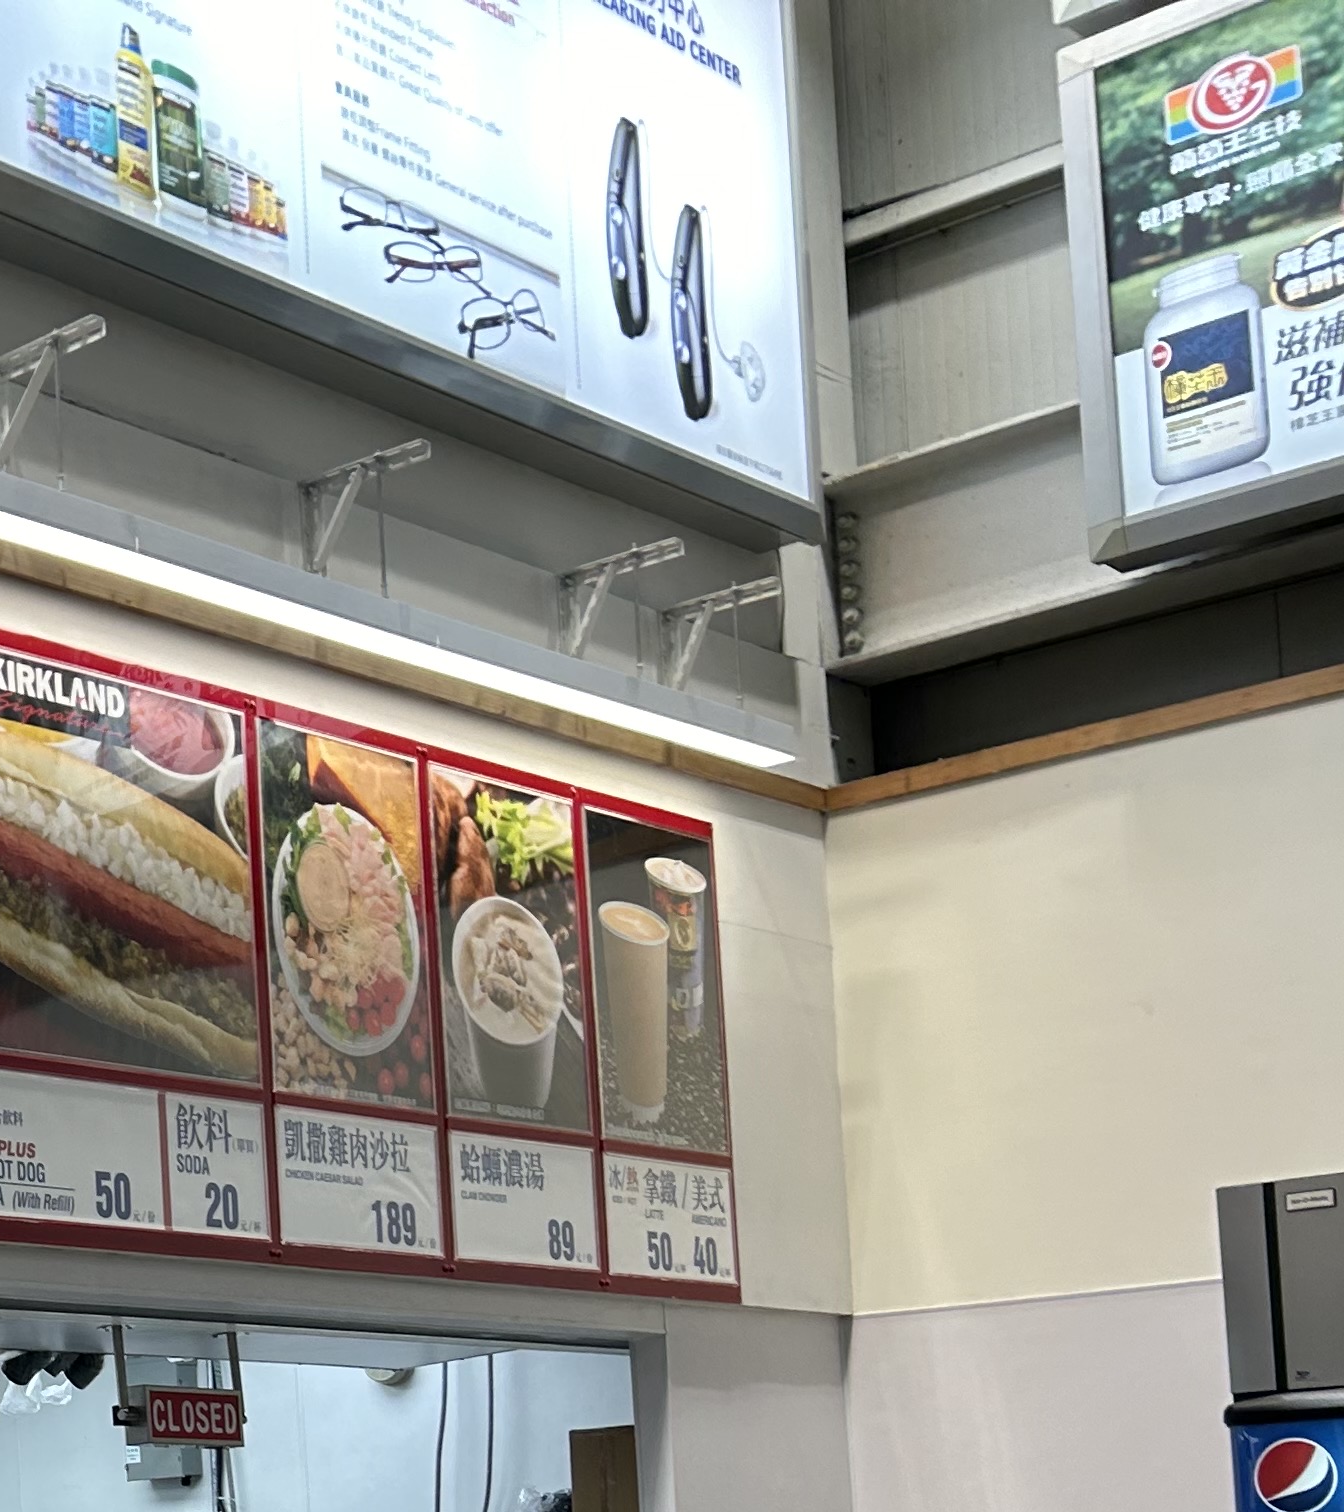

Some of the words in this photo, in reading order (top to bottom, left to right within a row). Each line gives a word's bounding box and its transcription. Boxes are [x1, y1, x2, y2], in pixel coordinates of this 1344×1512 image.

[661, 22, 686, 51] AID
[690, 39, 742, 86] CENTER
[1288, 359, 1344, 411] 強
[175, 1102, 233, 1154] 飲料
[284, 1119, 411, 1173] 凱撒雞肉沙拉
[17, 1162, 46, 1183] DOG
[176, 1153, 210, 1176] SODA
[12, 1189, 41, 1211] (With
[94, 1171, 131, 1220] 50
[205, 1182, 239, 1230] 20
[371, 1200, 416, 1247] 189
[548, 1218, 575, 1261] 89
[647, 1231, 673, 1272] 50
[694, 1236, 718, 1276] 40
[152, 1404, 238, 1435] CLOSED
